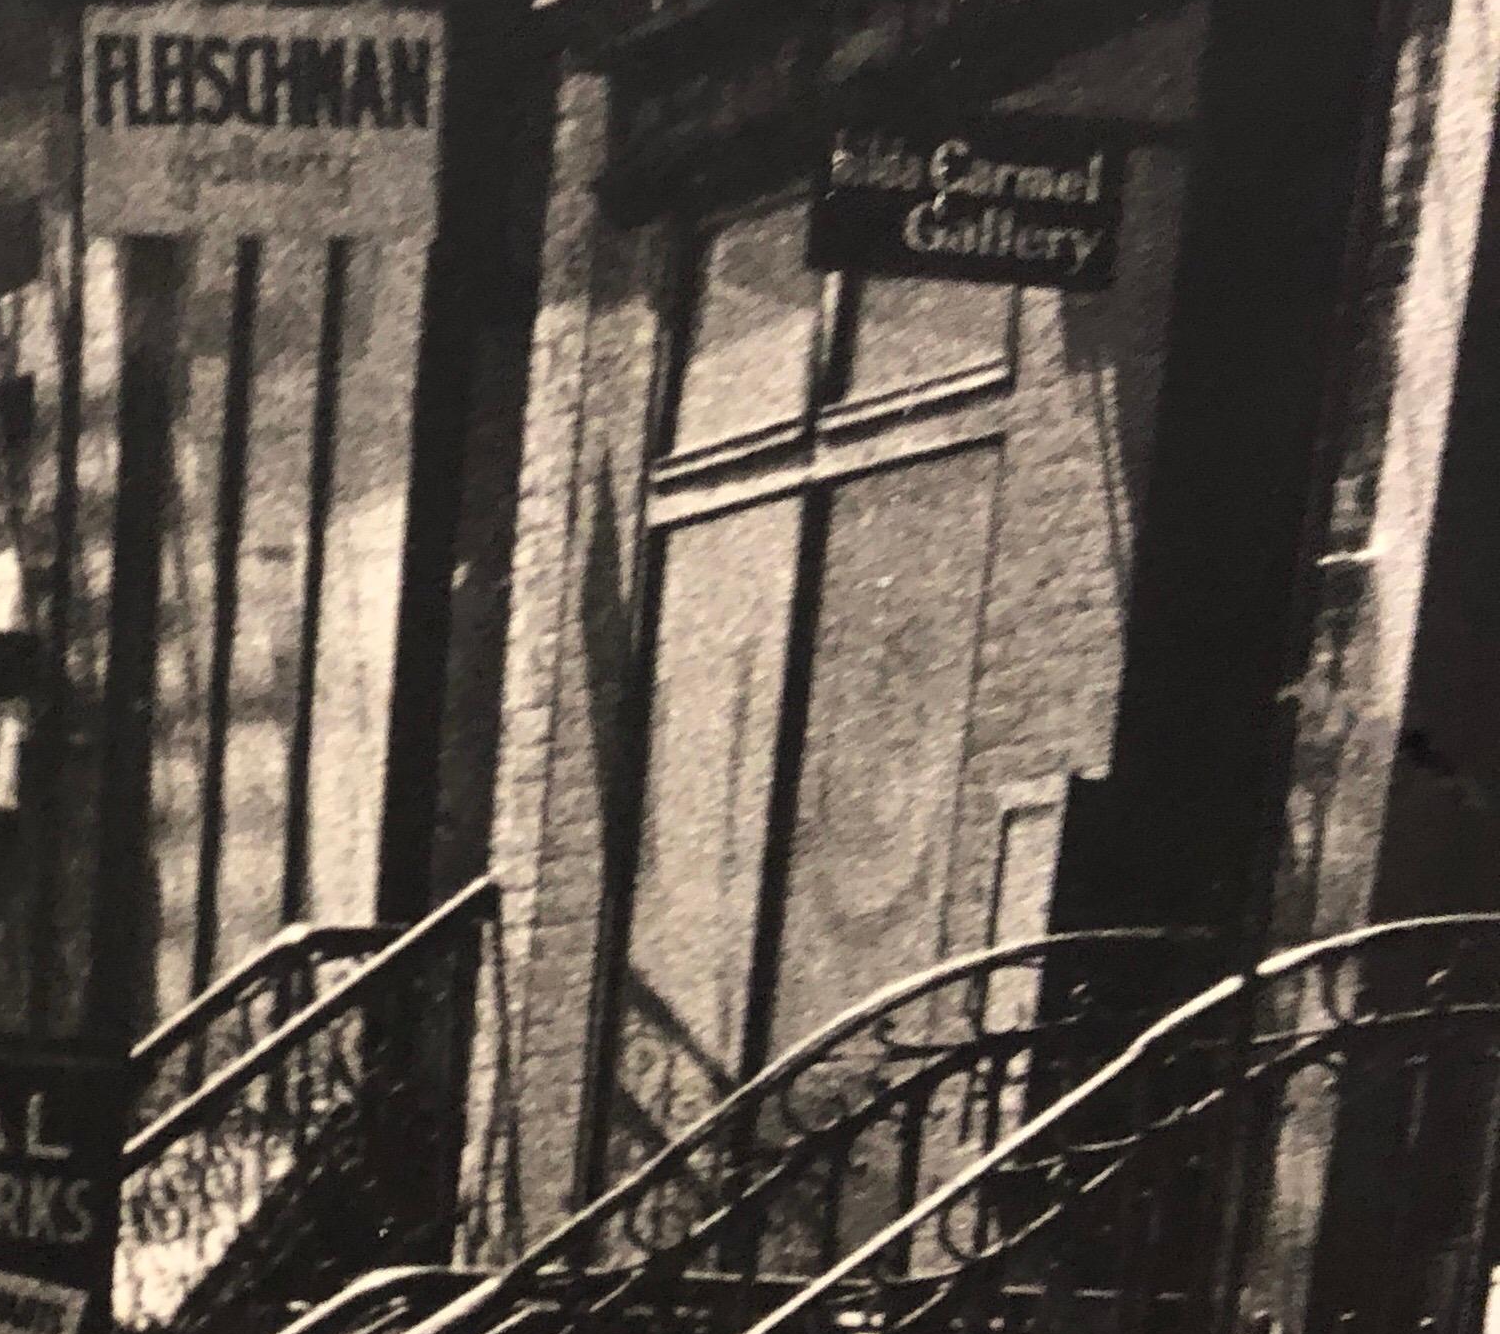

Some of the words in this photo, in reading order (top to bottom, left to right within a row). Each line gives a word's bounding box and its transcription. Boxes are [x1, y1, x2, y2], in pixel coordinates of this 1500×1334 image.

[94, 33, 431, 129] FLEISCHMAN
[928, 138, 1104, 205] Carmel
[903, 201, 1103, 275] Gallery
